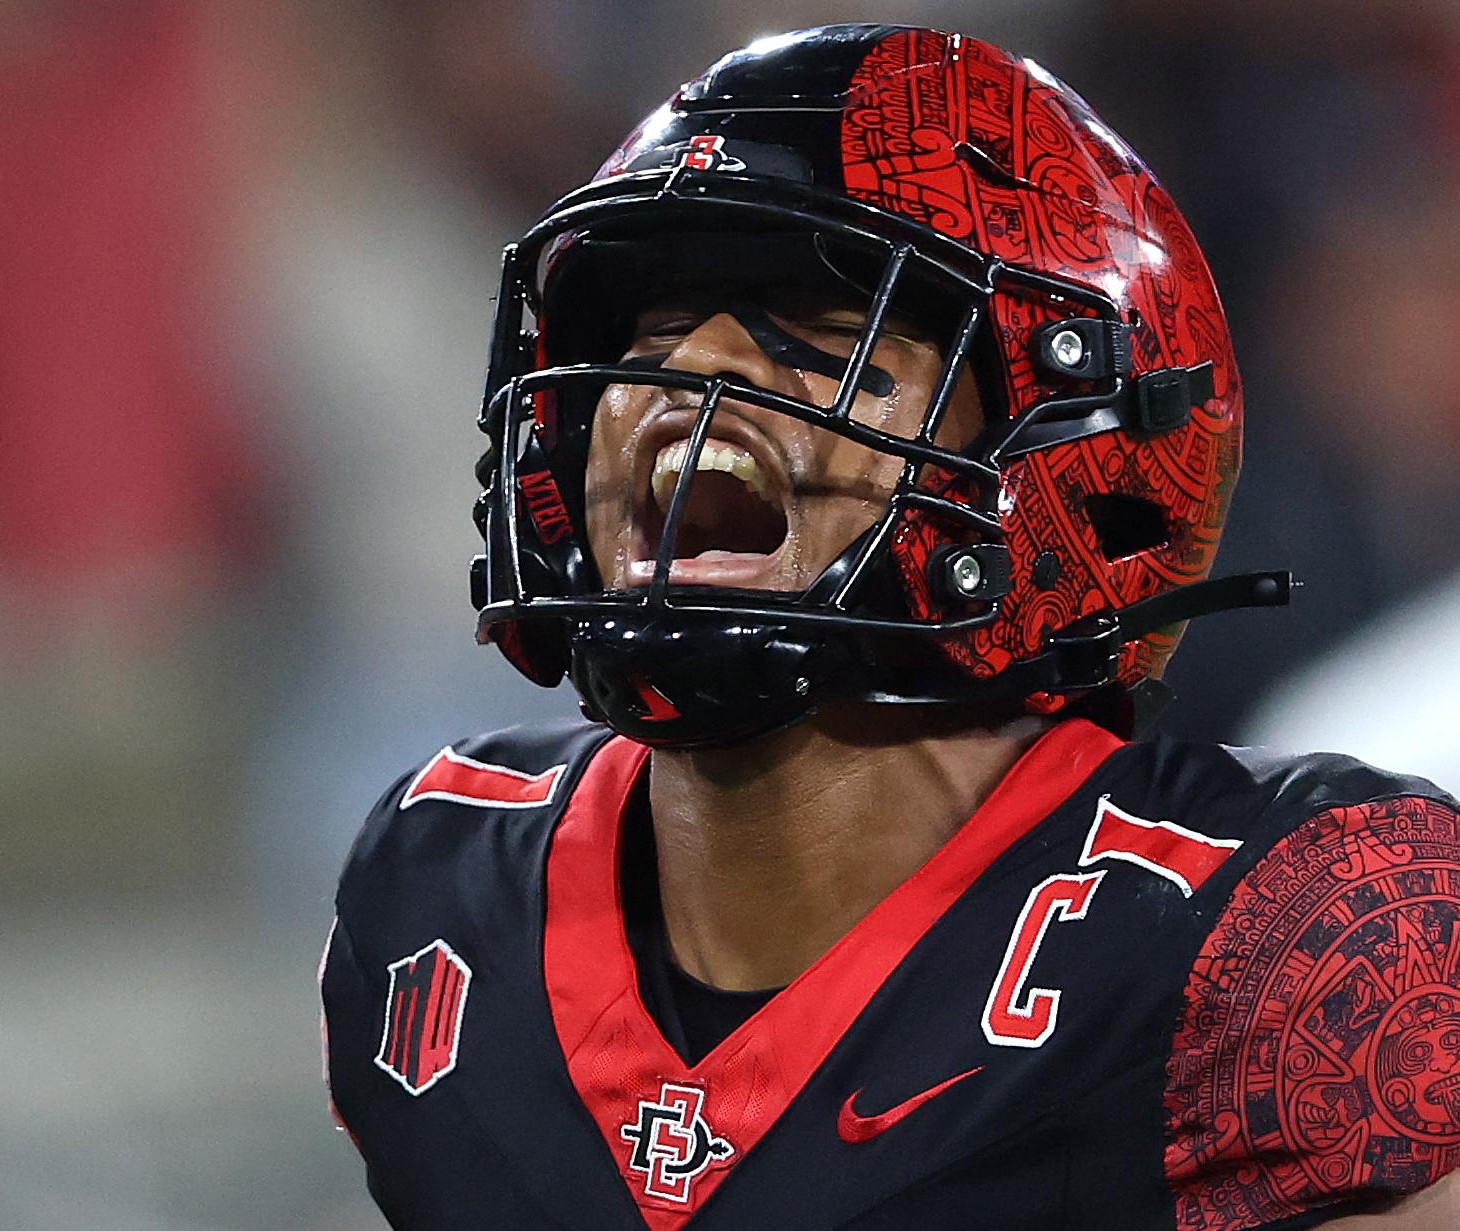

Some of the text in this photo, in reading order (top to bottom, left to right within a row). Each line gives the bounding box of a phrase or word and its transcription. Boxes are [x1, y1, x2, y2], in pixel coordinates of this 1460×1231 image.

[518, 469, 573, 544] AZTECS
[400, 747, 565, 810] 1
[1079, 794, 1243, 898] 1
[981, 870, 1107, 1047] C
